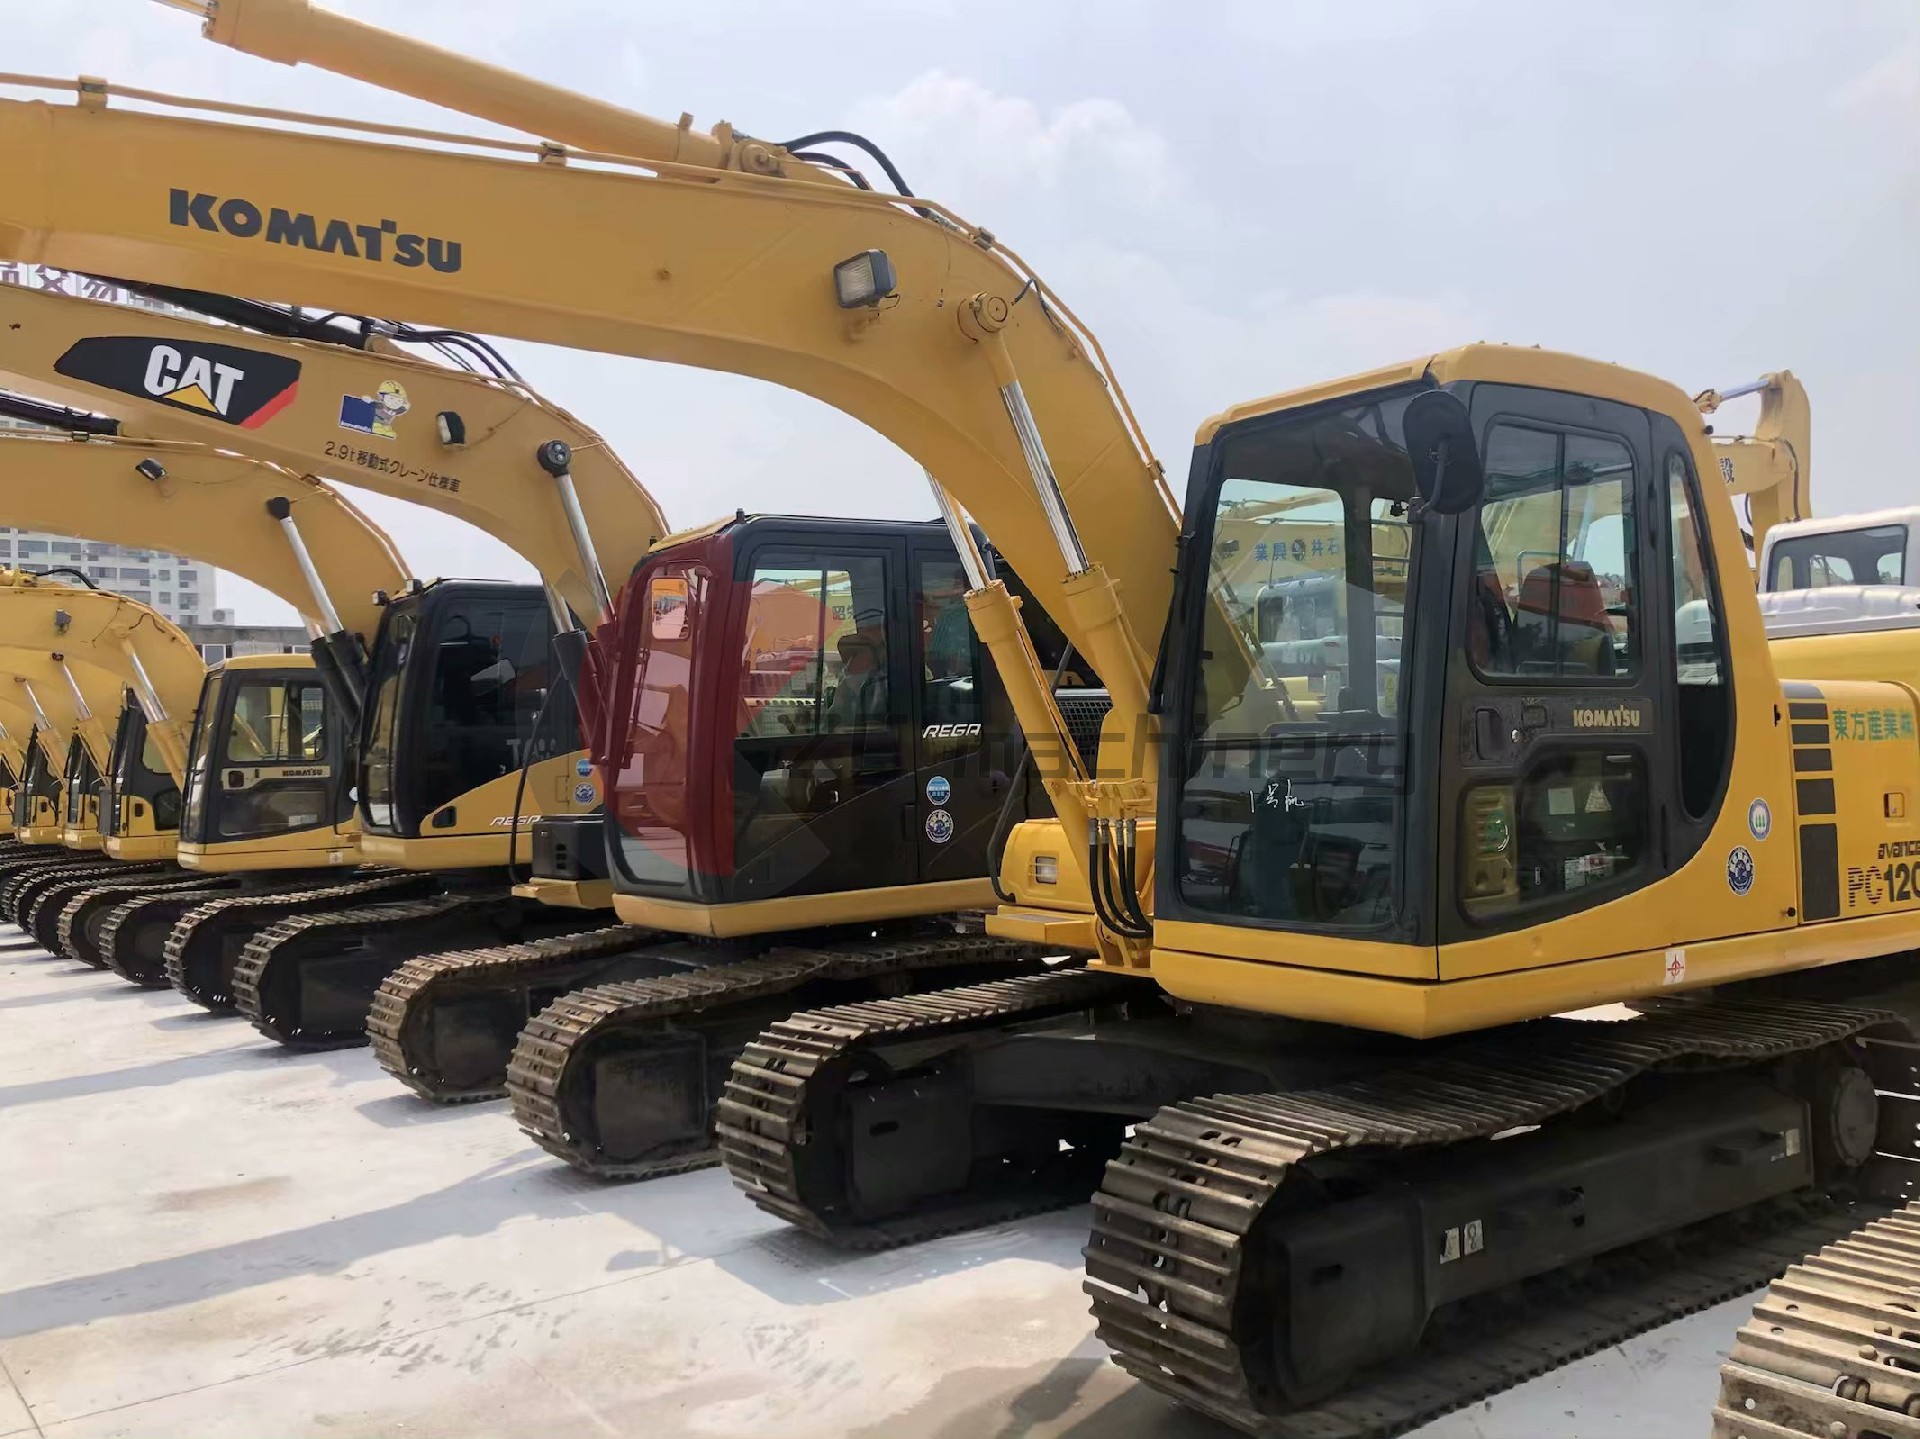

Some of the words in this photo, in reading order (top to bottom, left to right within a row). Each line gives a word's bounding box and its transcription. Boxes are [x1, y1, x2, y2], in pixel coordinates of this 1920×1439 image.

[170, 188, 462, 273] KOMATSU
[144, 345, 245, 416] CAT
[1573, 705, 1640, 727] KOMATSU
[923, 724, 982, 738] REGA
[282, 768, 324, 777] KOMATSU
